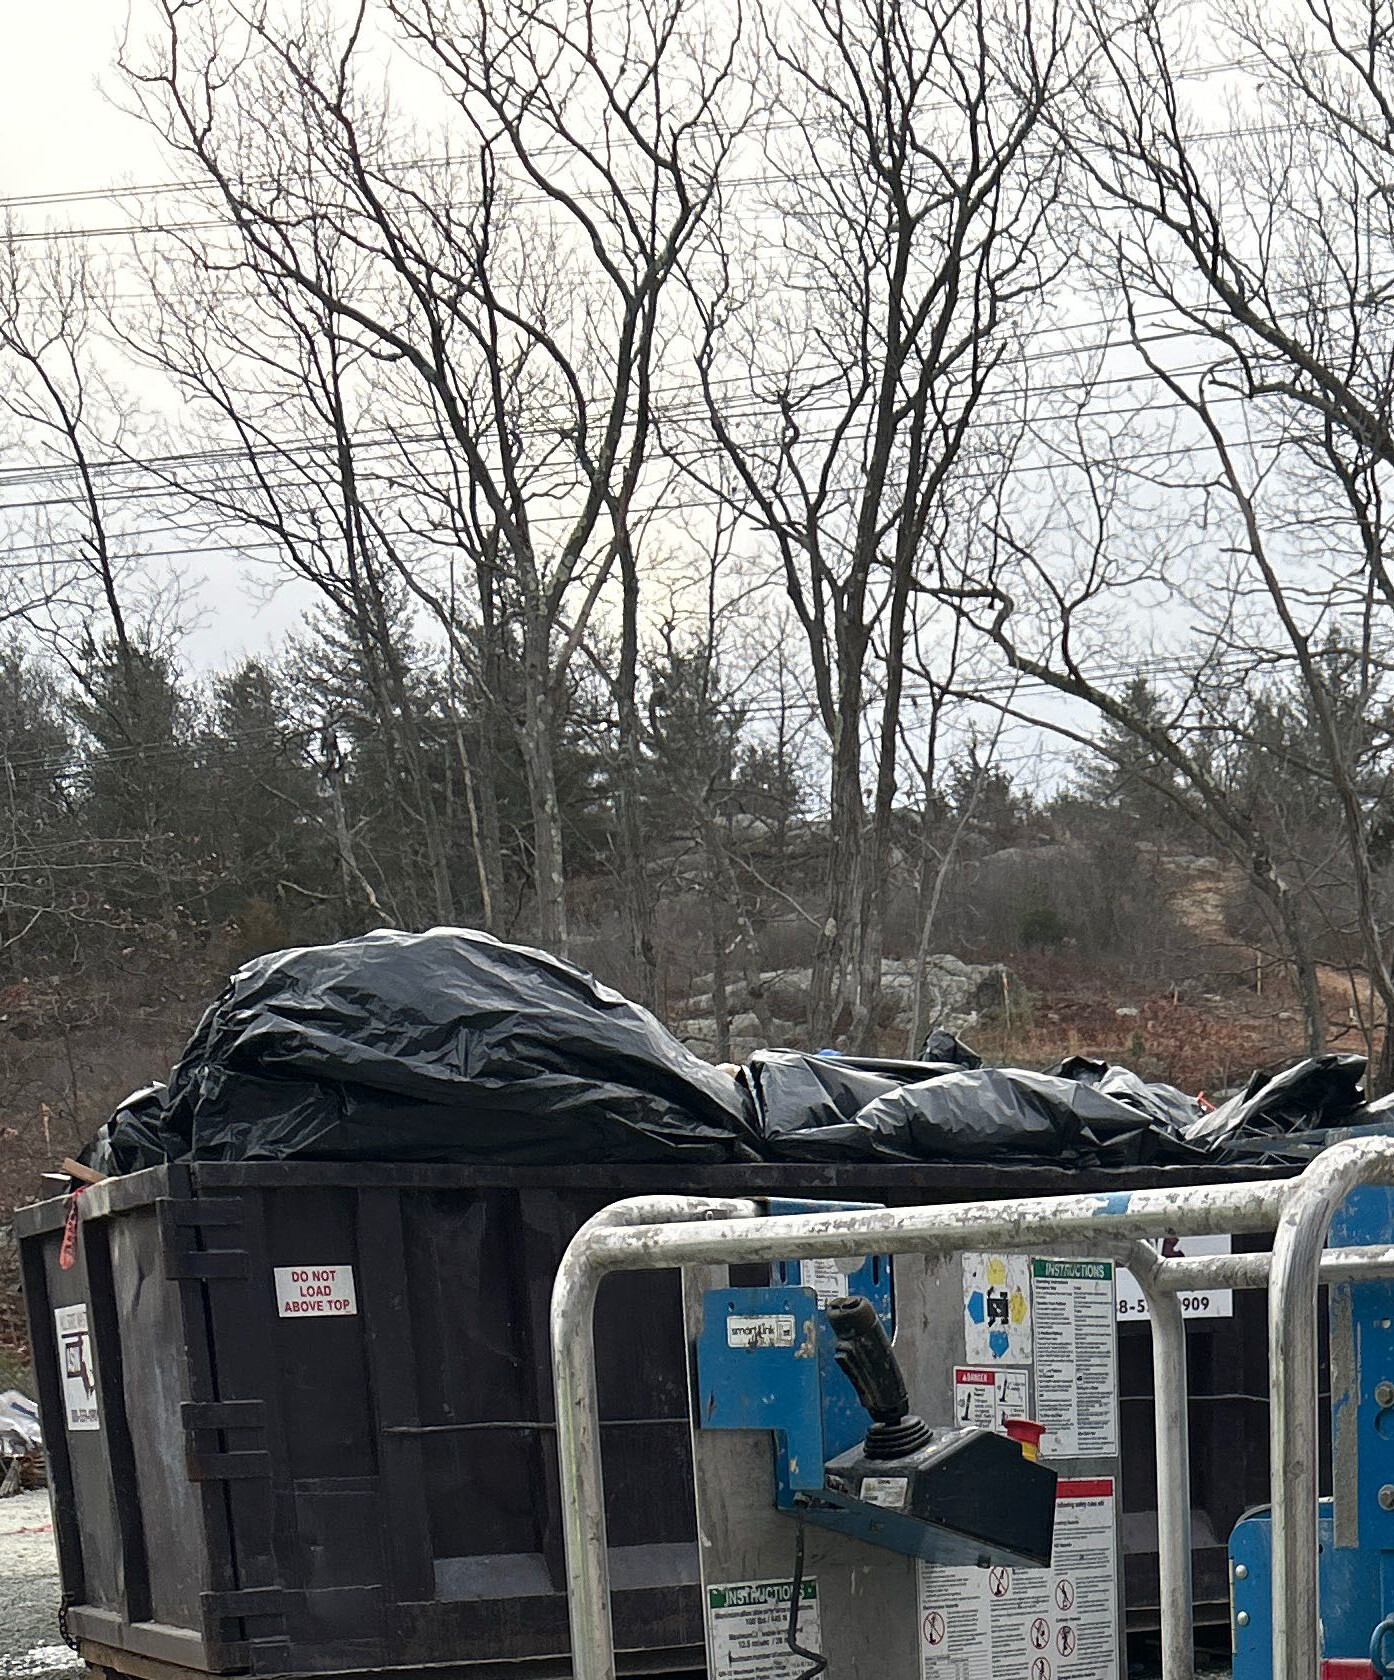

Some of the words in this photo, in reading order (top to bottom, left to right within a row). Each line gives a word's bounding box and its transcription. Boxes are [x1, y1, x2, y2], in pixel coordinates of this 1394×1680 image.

[291, 1271, 309, 1283] DO
[312, 1270, 337, 1282] NOT
[1045, 1262, 1105, 1279] INSTRUCTIONS
[299, 1285, 332, 1297] LOAD
[284, 1300, 324, 1313] ABOVE
[326, 1299, 350, 1311] TOP
